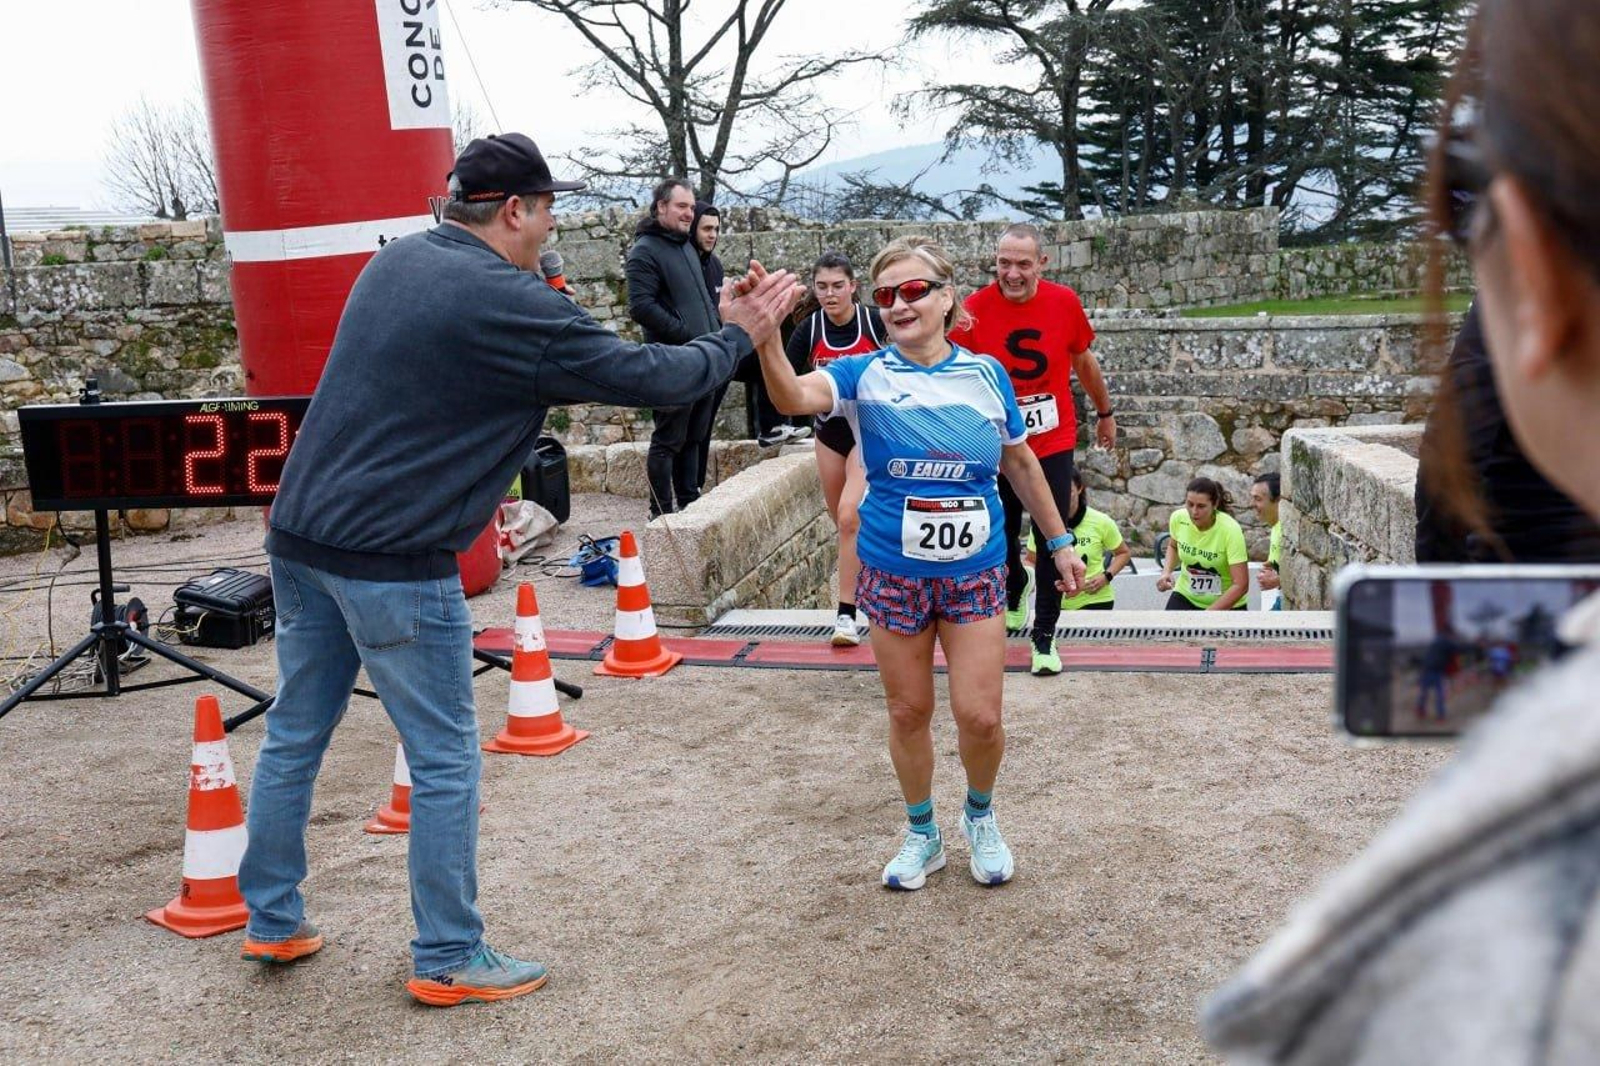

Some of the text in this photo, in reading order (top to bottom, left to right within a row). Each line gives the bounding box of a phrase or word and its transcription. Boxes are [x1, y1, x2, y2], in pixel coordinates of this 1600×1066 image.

[429, 27, 444, 80] DE
[1005, 328, 1048, 380] S
[1025, 409, 1042, 428] 61
[912, 461, 966, 478] EAUTO
[919, 521, 974, 550] 206
[1190, 577, 1213, 590] 277
